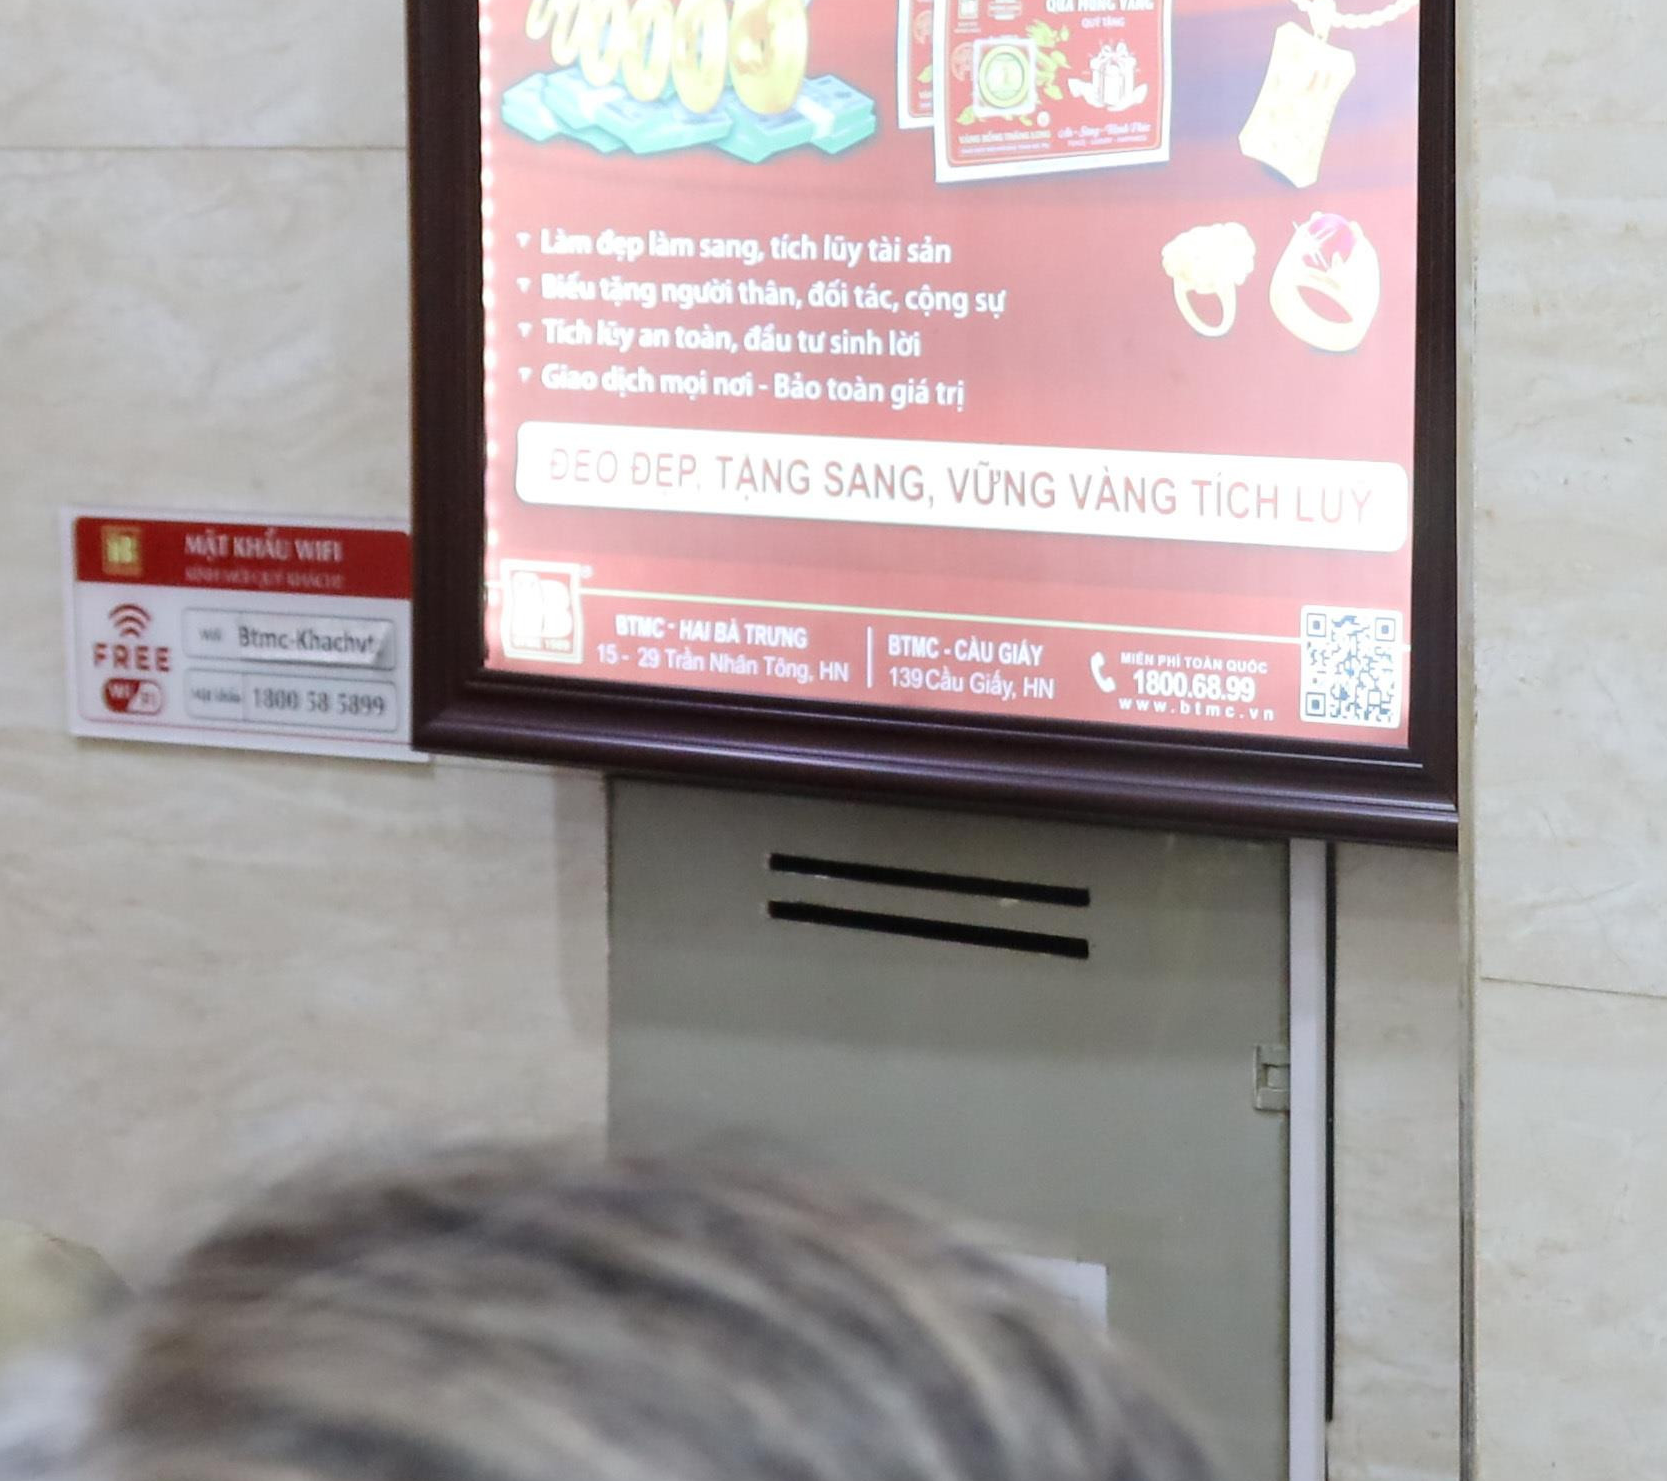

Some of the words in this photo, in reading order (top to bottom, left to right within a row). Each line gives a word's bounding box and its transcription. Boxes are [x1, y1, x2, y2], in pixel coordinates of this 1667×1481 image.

[540, 227, 593, 255] Làm
[596, 228, 645, 262] đẹp
[648, 229, 696, 258] làm
[699, 236, 765, 266] sang,
[769, 233, 818, 261] tích
[823, 233, 864, 268] lũy
[867, 235, 902, 263] tài
[906, 235, 952, 264] sản
[599, 275, 658, 309] tặng
[661, 278, 734, 310] người
[737, 278, 803, 310] thân,
[807, 277, 849, 309] đối
[853, 282, 900, 313] tác,
[904, 283, 970, 320] cộng
[975, 288, 1008, 320] sự
[541, 317, 594, 346] Tích
[596, 319, 635, 353] lũy
[638, 327, 671, 349] an
[674, 323, 739, 354] toàn,
[796, 330, 827, 354] tư
[829, 328, 883, 356] sinh
[888, 329, 921, 358] lời
[541, 362, 599, 391] Giao
[600, 364, 655, 399] dịch
[659, 369, 708, 402] mọi
[712, 371, 754, 397] nơi
[774, 371, 822, 401] Bảo
[826, 375, 885, 403] toàn
[890, 377, 930, 411] giá
[935, 379, 965, 413] trị
[549, 446, 619, 485] ĐEO
[822, 459, 936, 509] SANG,
[946, 460, 1056, 509] VỮNG
[1068, 464, 1177, 516] VÀNG
[1191, 471, 1280, 522] TÍCH
[616, 614, 665, 640] BTMC
[679, 618, 712, 643] HAI
[714, 618, 742, 645] BÀ
[888, 633, 940, 660] BTMC
[93, 641, 171, 673] FREE
[709, 651, 759, 677] Nhân
[819, 661, 850, 683] HN
[1022, 677, 1056, 700] HN
[1132, 668, 1256, 703] 1800.68.99
